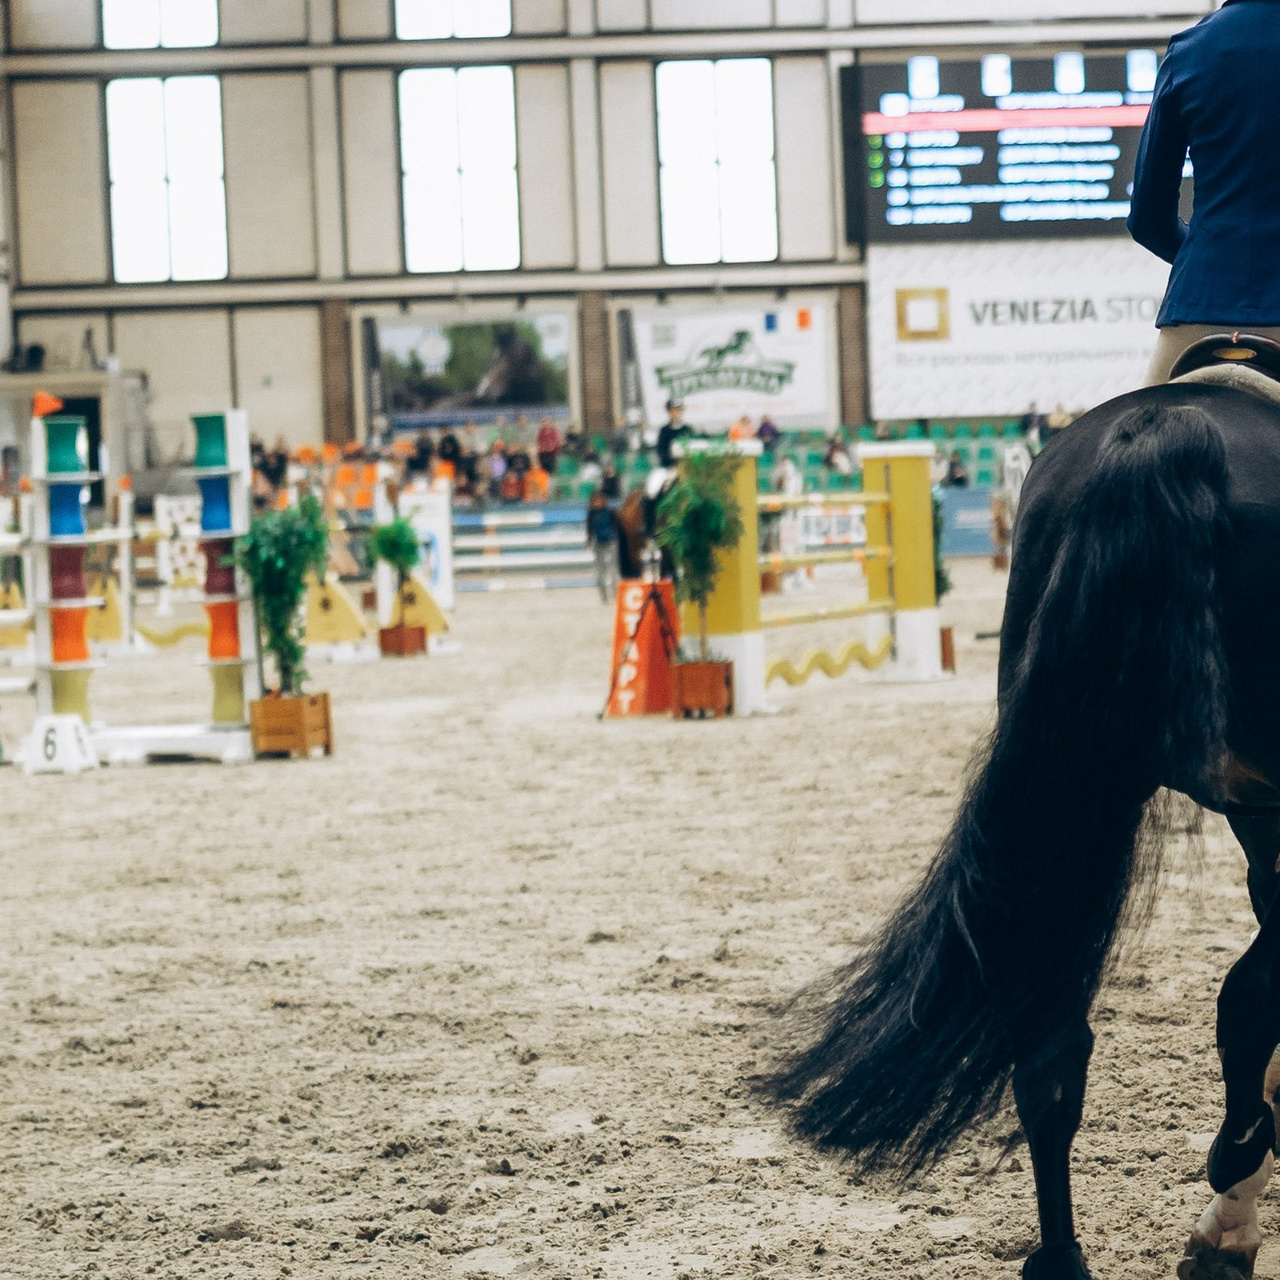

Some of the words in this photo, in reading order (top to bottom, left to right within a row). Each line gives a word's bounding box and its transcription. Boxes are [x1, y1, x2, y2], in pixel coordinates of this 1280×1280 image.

[970, 297, 1098, 325] VENEZIA
[618, 586, 644, 715] СТАРТ
[44, 726, 57, 761] 6
